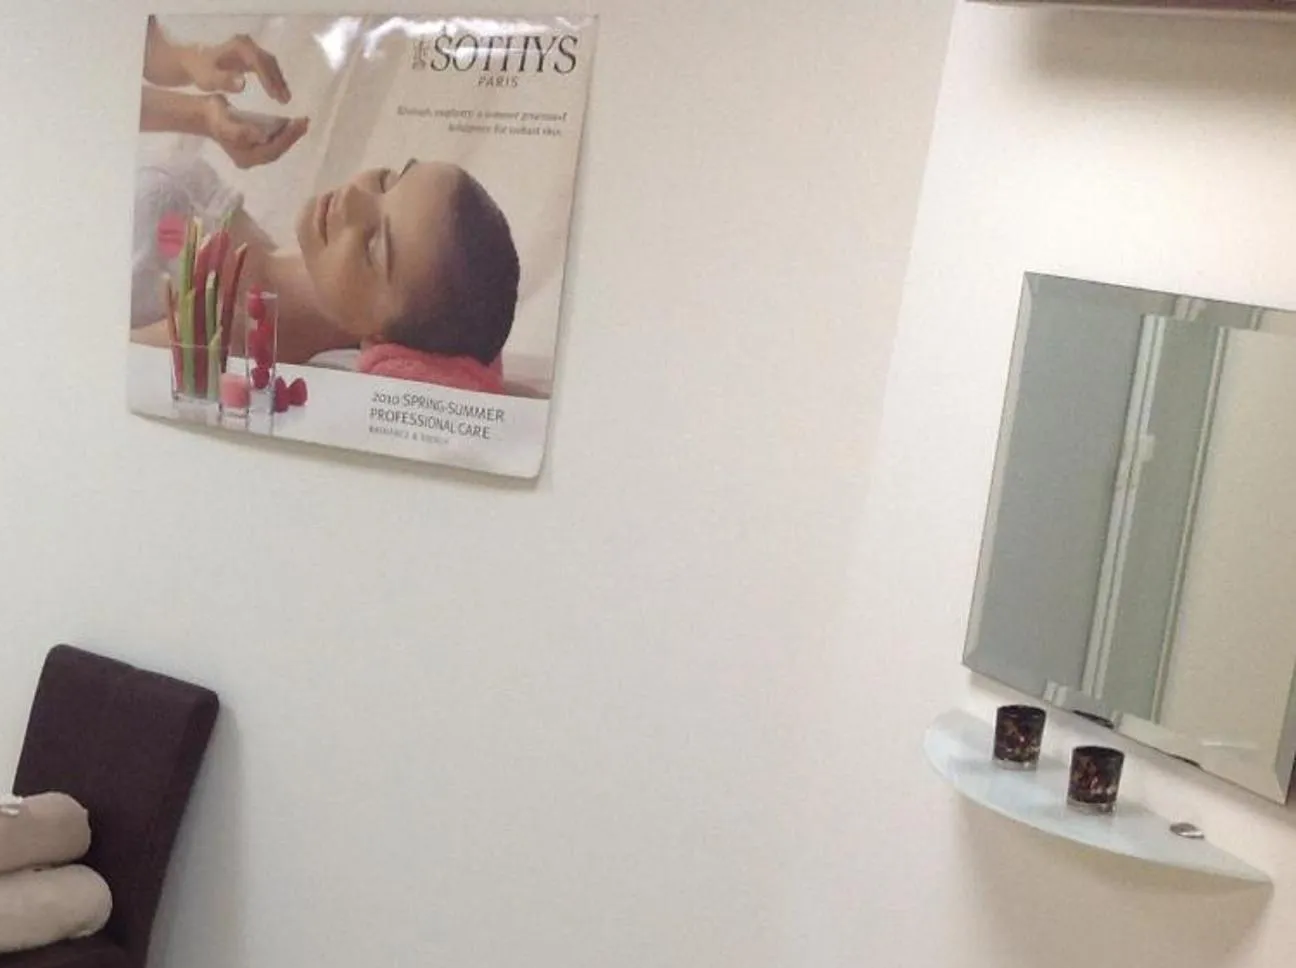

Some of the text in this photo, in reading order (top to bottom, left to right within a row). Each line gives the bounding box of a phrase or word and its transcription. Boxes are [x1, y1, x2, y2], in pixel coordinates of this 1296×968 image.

[430, 34, 578, 74] SOTHYS
[477, 75, 519, 88] PARIS
[371, 392, 401, 405] 2010
[369, 407, 455, 434] PROFESSIONAL
[457, 421, 491, 440] CARE
